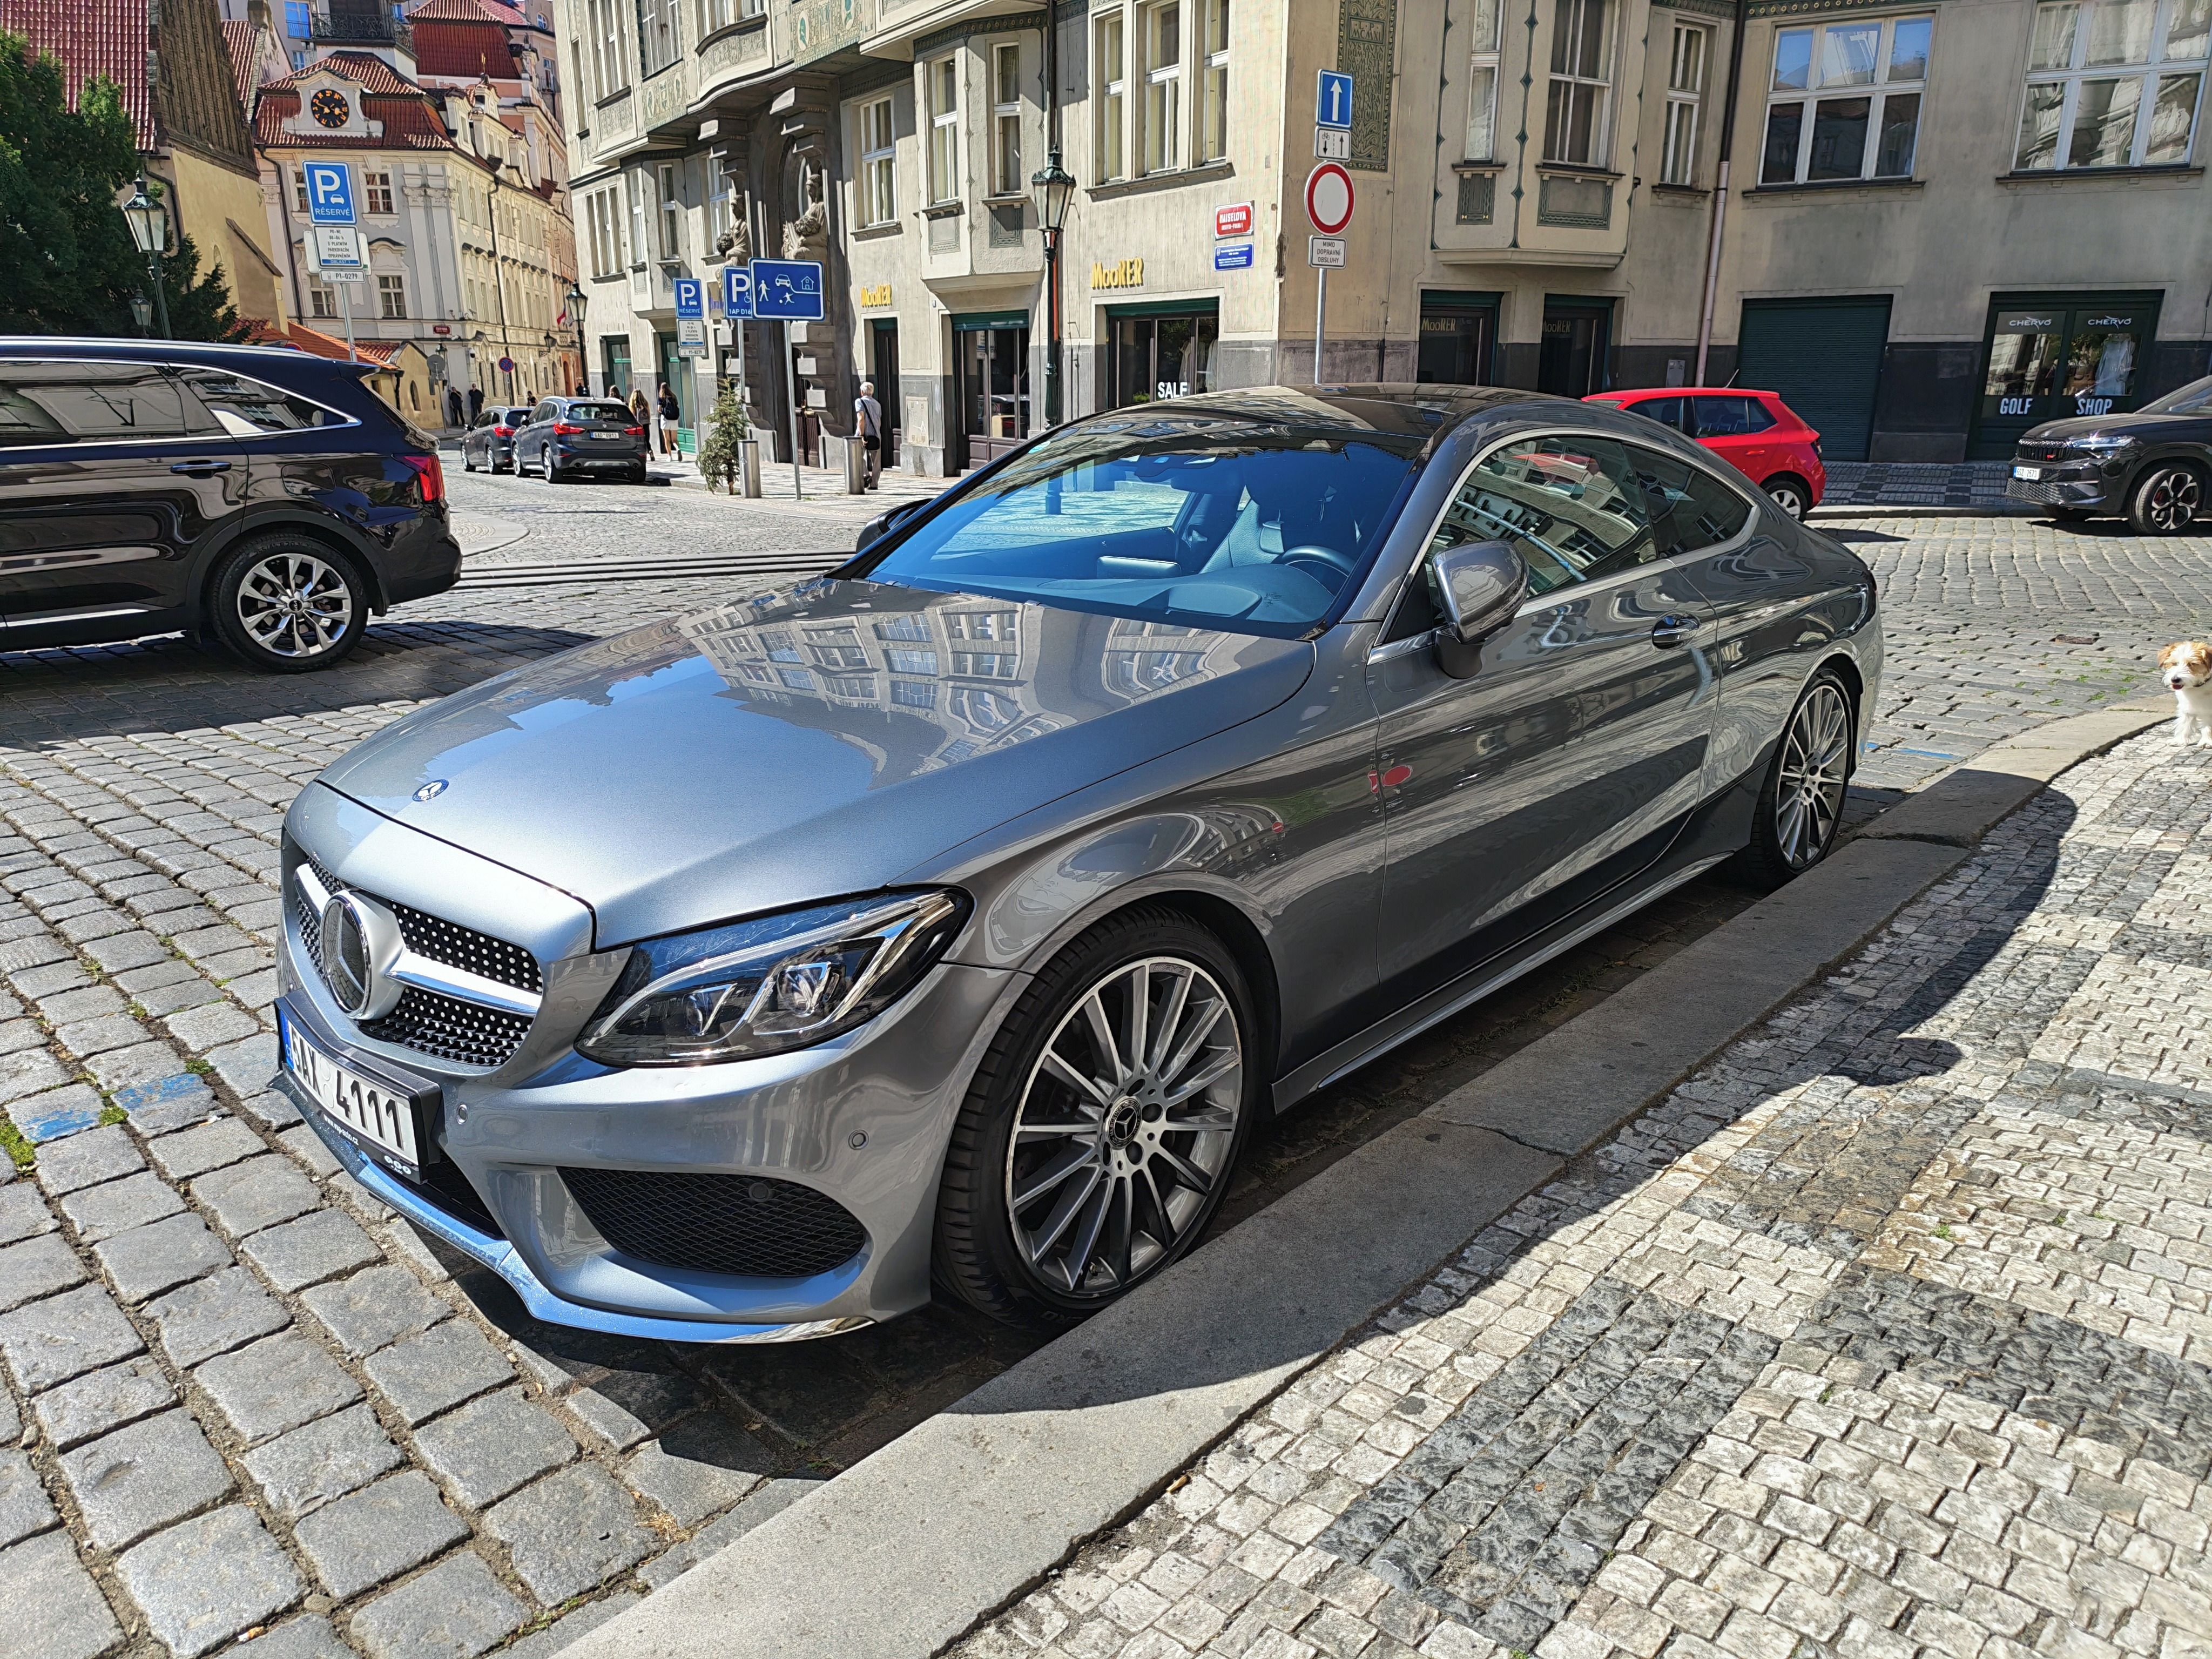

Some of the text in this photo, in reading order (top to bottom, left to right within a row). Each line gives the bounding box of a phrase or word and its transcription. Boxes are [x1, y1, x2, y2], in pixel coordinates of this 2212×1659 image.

[314, 170, 340, 204] P
[315, 207, 351, 216] RÉSERVÉ
[1219, 211, 1246, 224] MAISELOVA
[680, 284, 696, 306] P
[731, 273, 750, 302] P
[2000, 397, 2033, 415] GOLF
[2076, 398, 2113, 415] SHOP
[291, 1024, 323, 1099] 5AX
[336, 1069, 404, 1151] 4111
